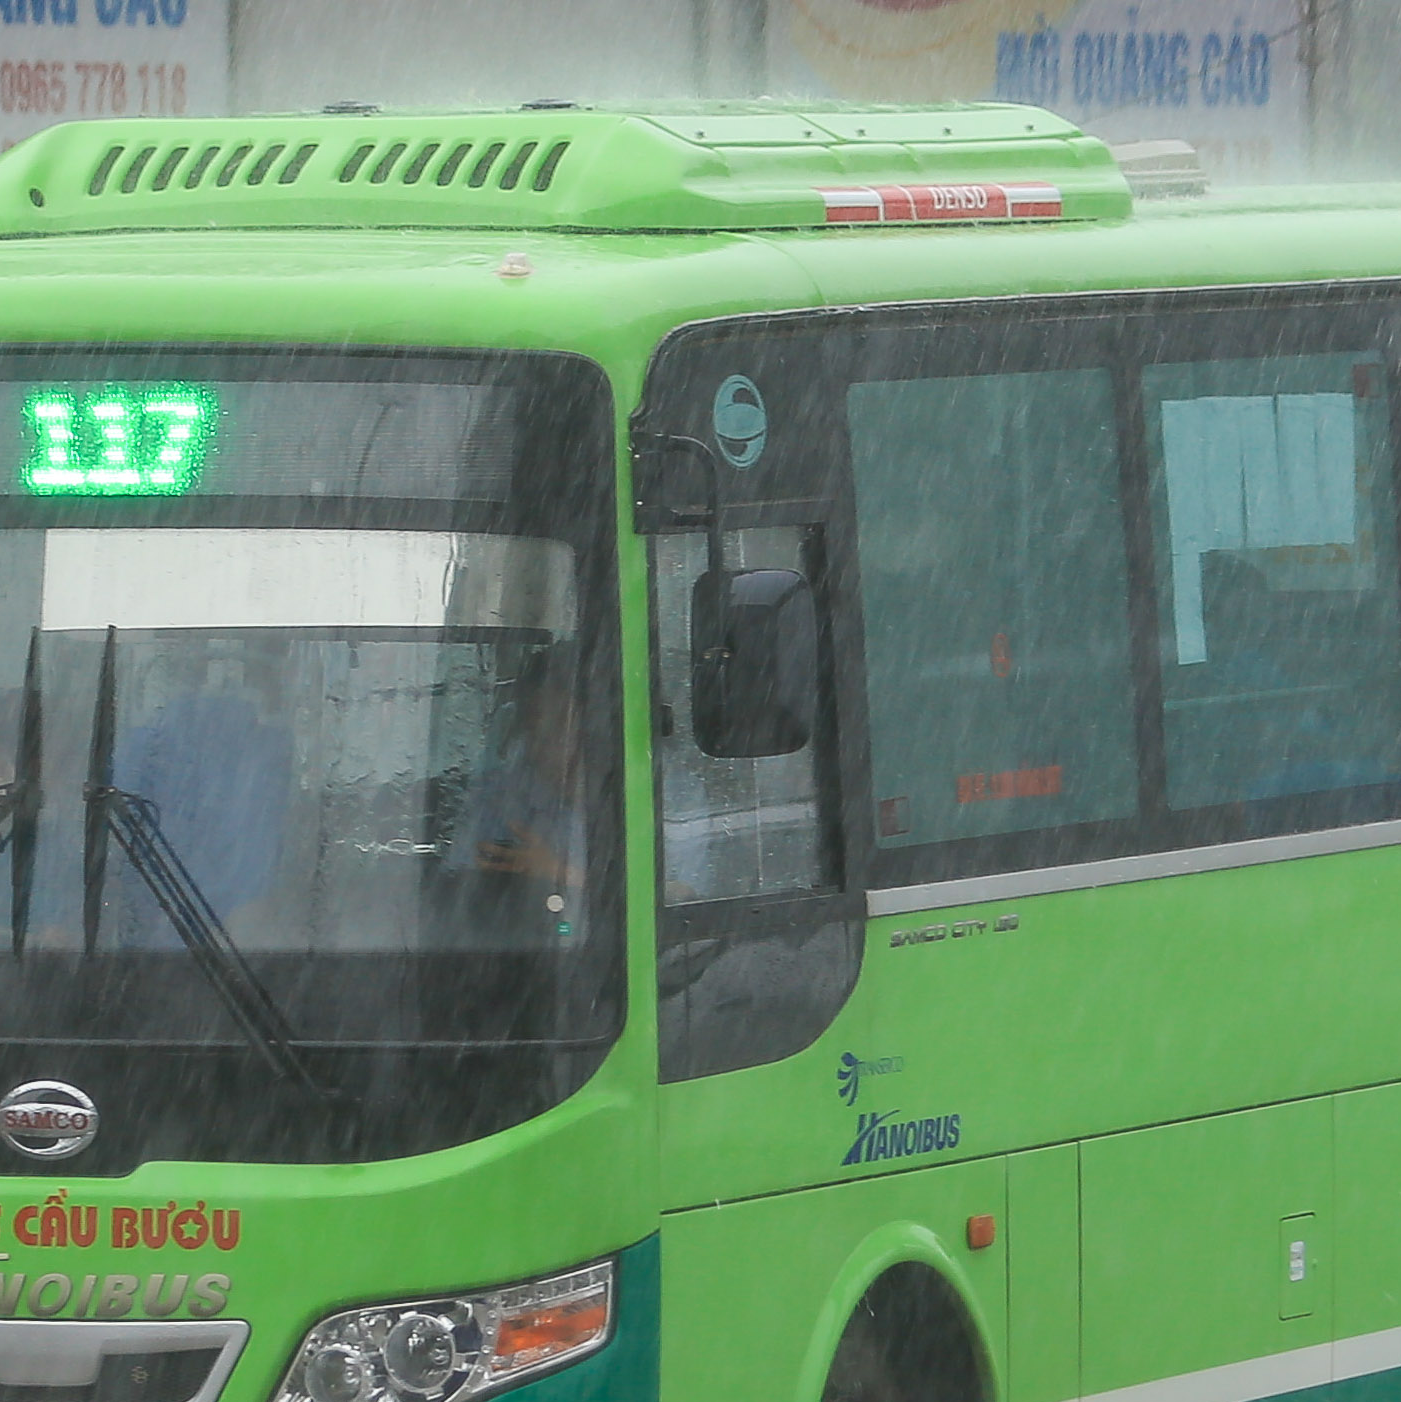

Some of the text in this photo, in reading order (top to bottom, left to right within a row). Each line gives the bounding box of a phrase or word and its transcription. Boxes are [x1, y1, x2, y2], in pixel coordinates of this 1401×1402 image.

[0, 60, 66, 115] 0965
[74, 61, 127, 115] 778
[137, 61, 188, 116] 118
[929, 185, 989, 210] DENSO
[28, 393, 205, 491] 117
[4, 1111, 89, 1131] SAMCO
[841, 1109, 961, 1167] HANOIBUS
[13, 1187, 98, 1248] CẦU
